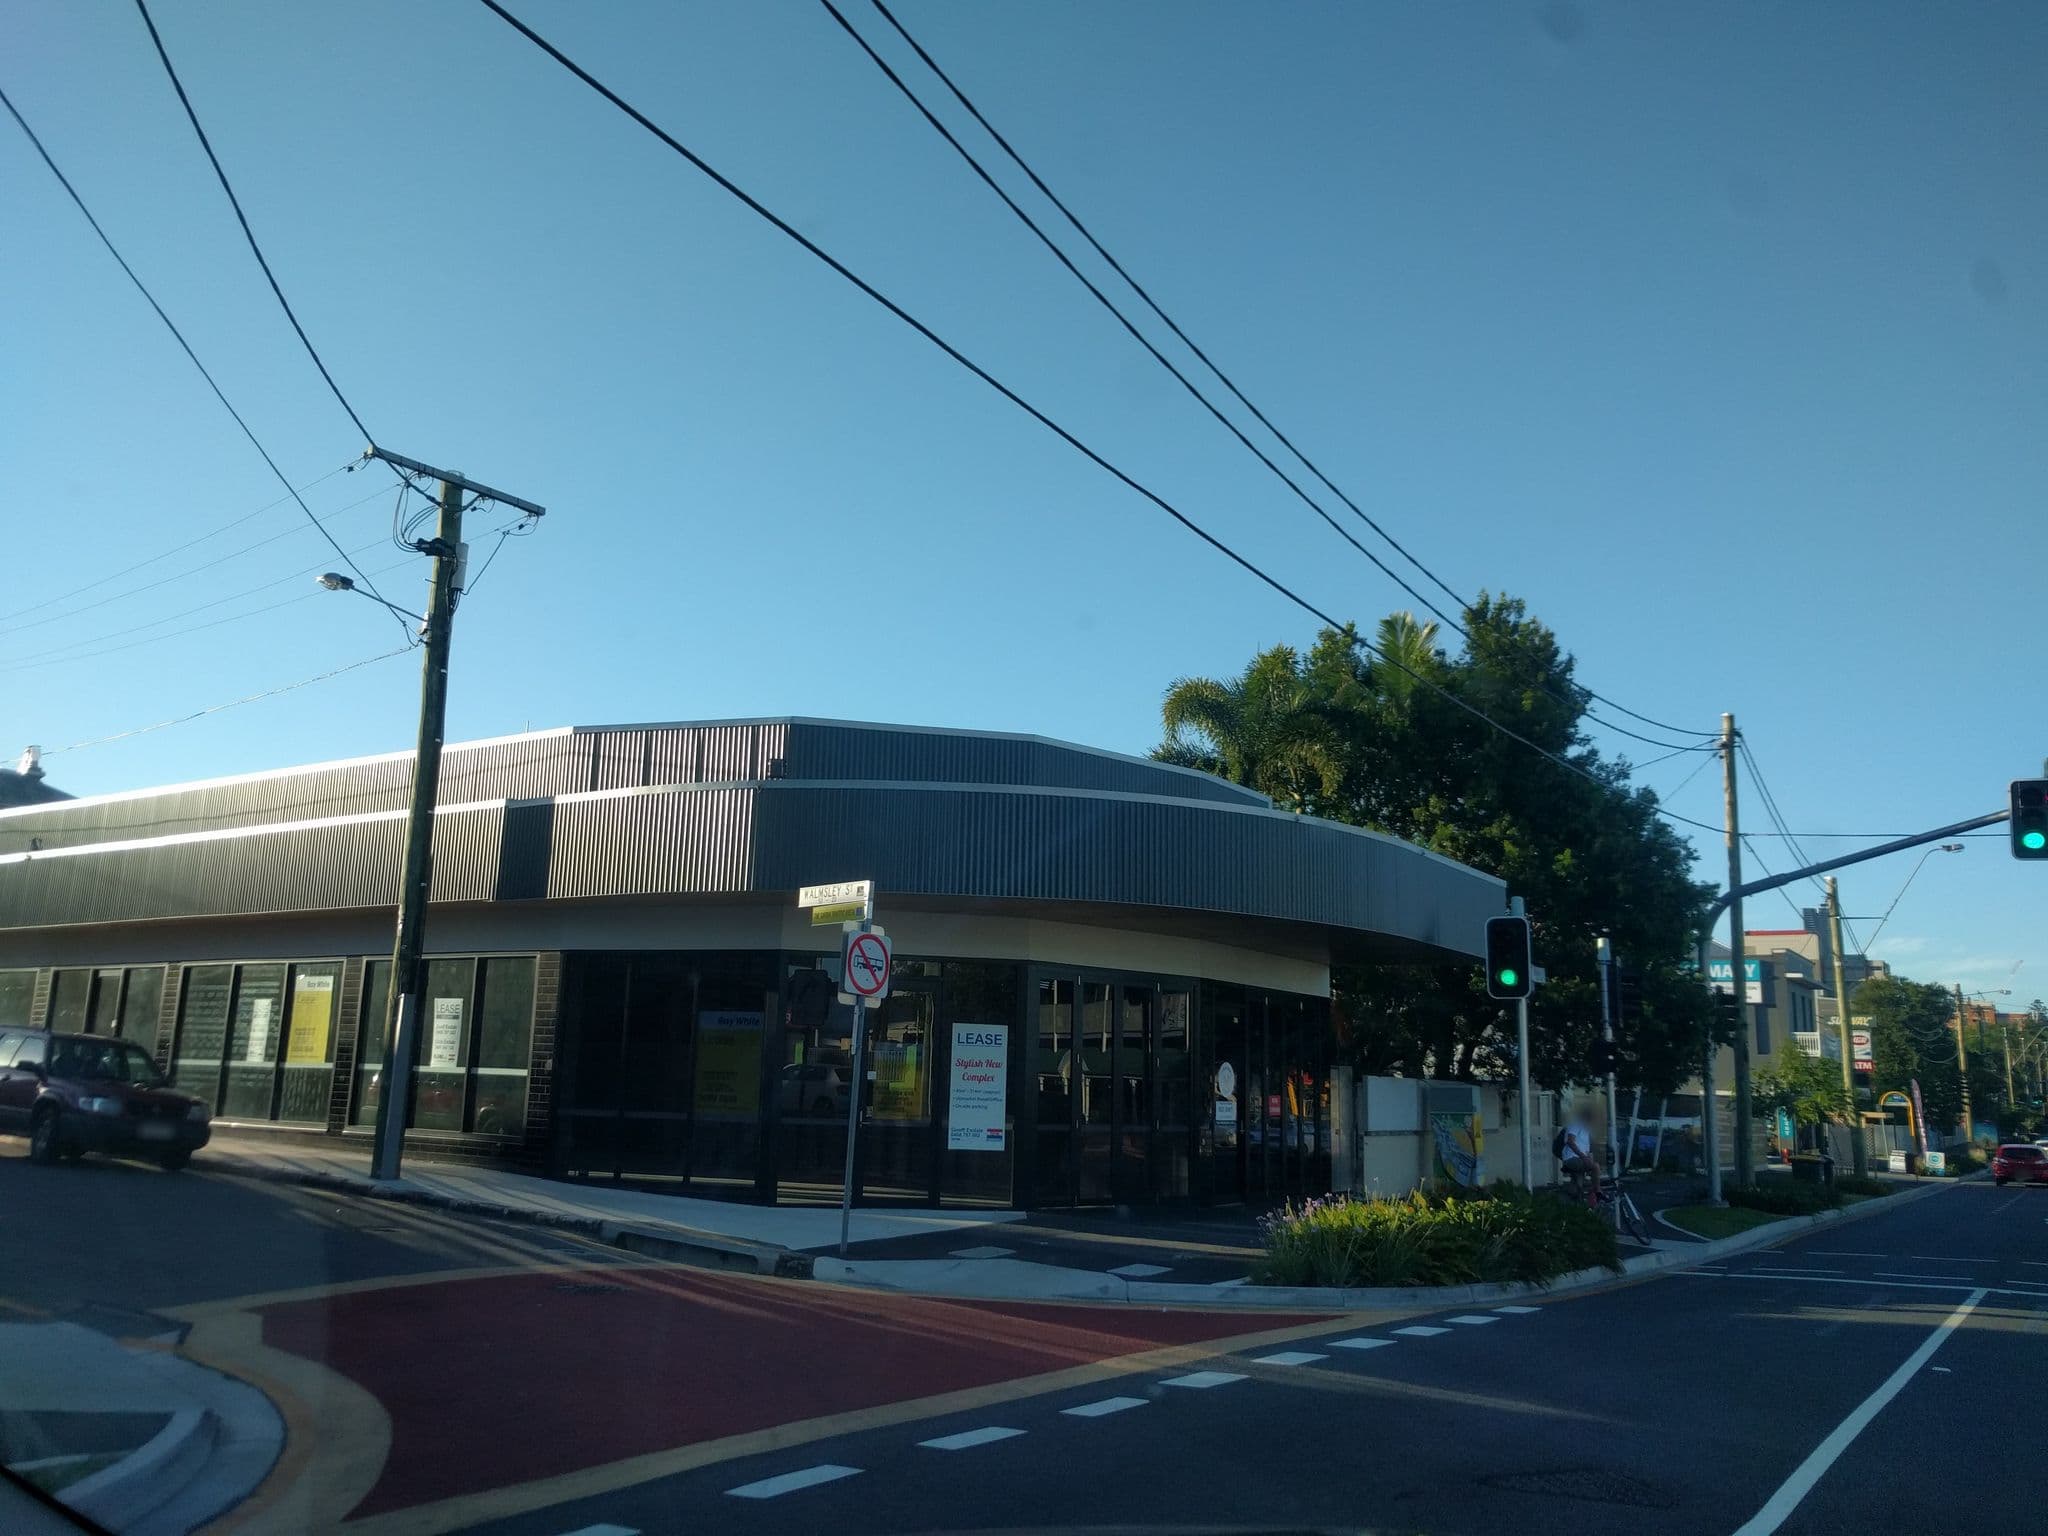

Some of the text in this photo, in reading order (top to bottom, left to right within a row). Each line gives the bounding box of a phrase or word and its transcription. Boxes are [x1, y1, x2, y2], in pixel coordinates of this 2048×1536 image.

[804, 885, 841, 899] WALMSLEY
[436, 1003, 460, 1013] LEASE
[735, 1016, 760, 1025] White
[1827, 1016, 1873, 1026] SUWAY
[957, 1033, 1003, 1046] LEASE
[955, 1058, 1003, 1069] Stylish New
[962, 1072, 995, 1085] Complex
